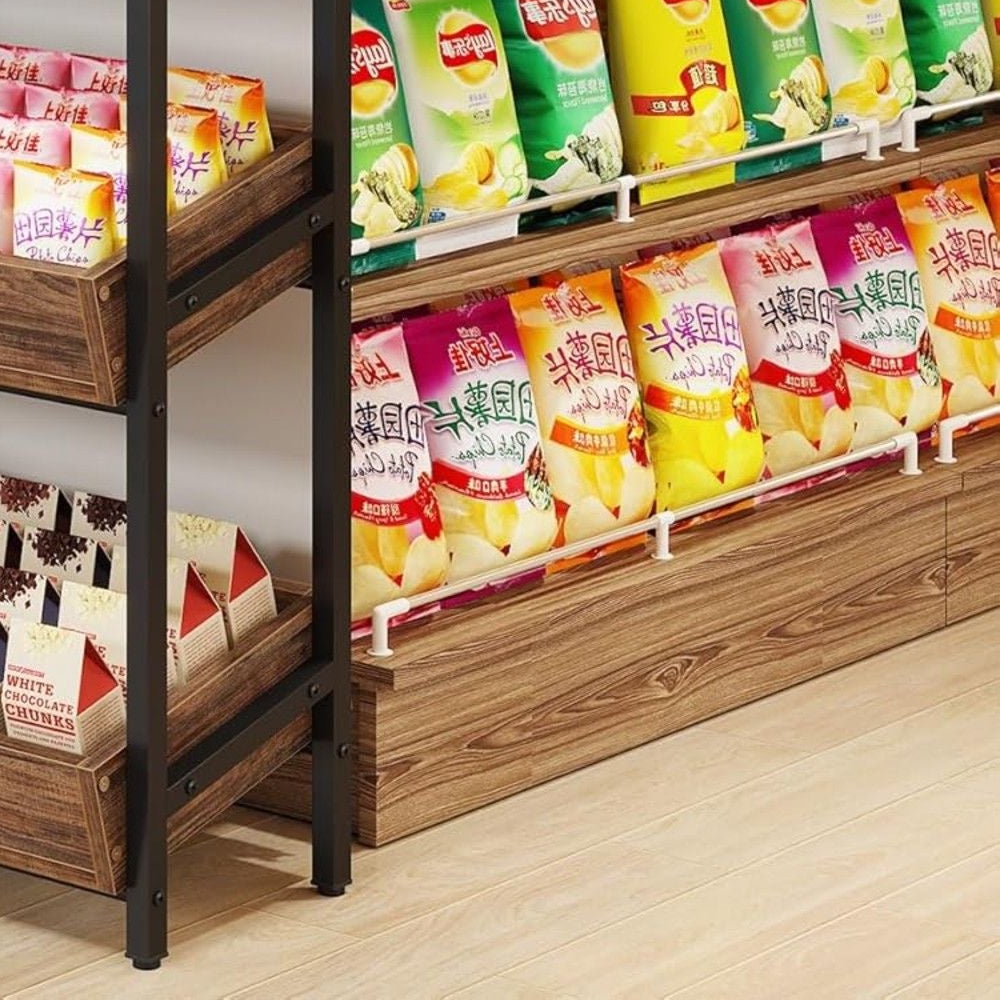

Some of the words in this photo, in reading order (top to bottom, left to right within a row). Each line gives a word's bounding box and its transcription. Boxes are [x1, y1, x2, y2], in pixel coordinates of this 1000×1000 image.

[43, 102, 91, 126] 上好佳
[7, 673, 55, 697] WHITE
[4, 688, 74, 715] CHOCOLATE
[5, 703, 75, 731] CHUNKS
